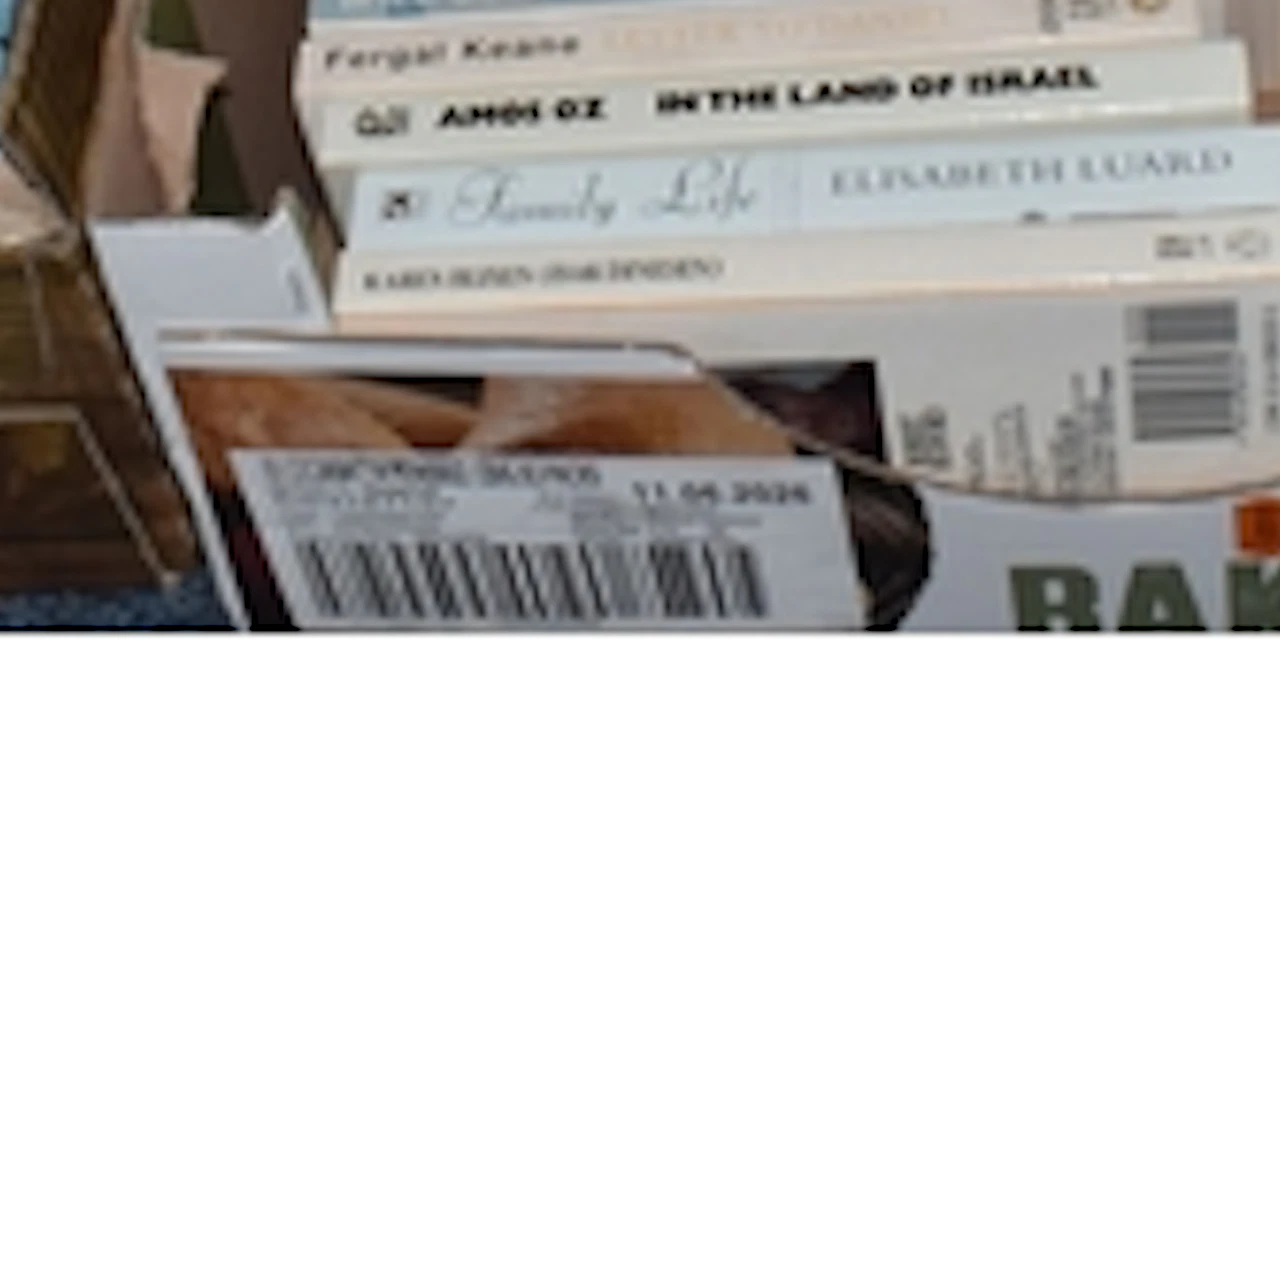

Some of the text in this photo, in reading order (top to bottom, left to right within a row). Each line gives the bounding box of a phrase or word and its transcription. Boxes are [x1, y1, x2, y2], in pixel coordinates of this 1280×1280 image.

[323, 40, 450, 73] Fergal
[461, 34, 582, 62] Keane
[434, 63, 1100, 131] AMOS OZ IN THE LAND OF ISRAEL
[830, 146, 1234, 197] ELISABETH LUARD
